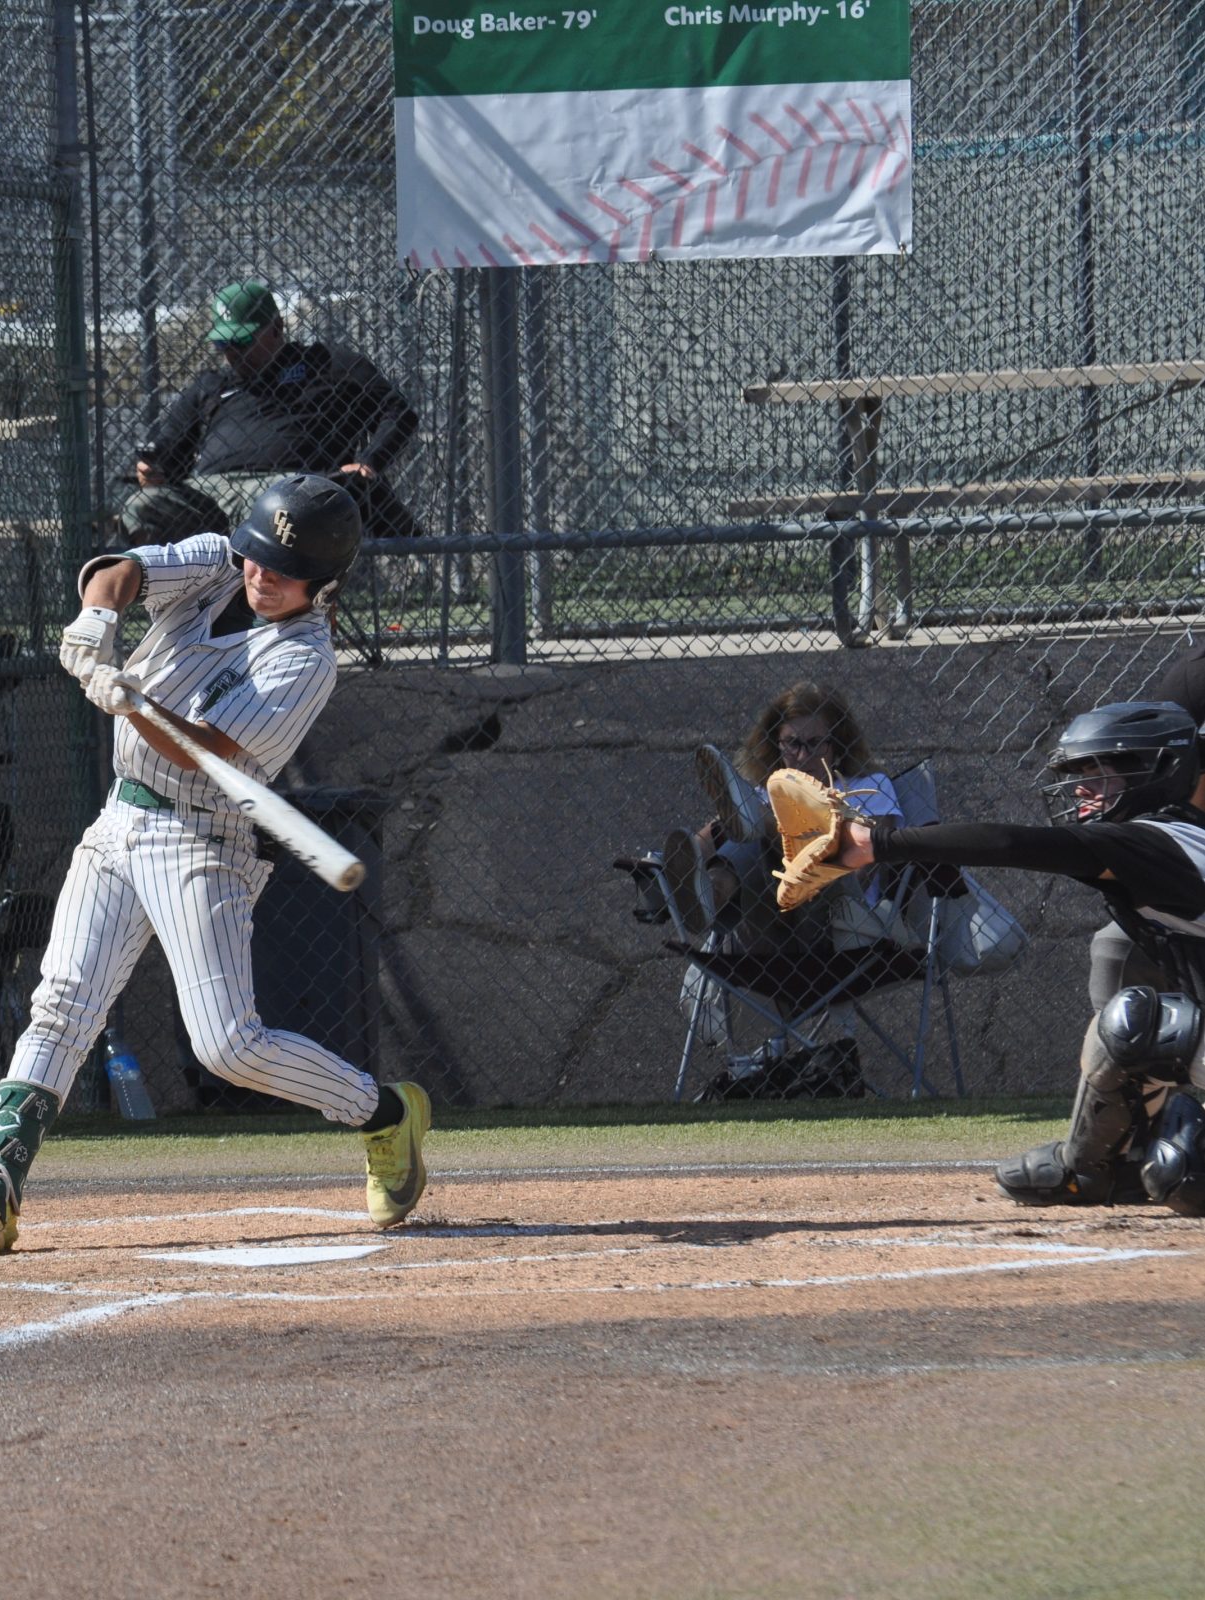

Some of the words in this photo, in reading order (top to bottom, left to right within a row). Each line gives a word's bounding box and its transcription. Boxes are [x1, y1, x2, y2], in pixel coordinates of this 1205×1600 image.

[413, 15, 475, 39] Doug
[480, 11, 556, 32] Baker-
[562, 10, 597, 30] 79'
[664, 5, 723, 26] Chris
[728, 1, 830, 27] Murphy-
[836, 0, 870, 19] 16'
